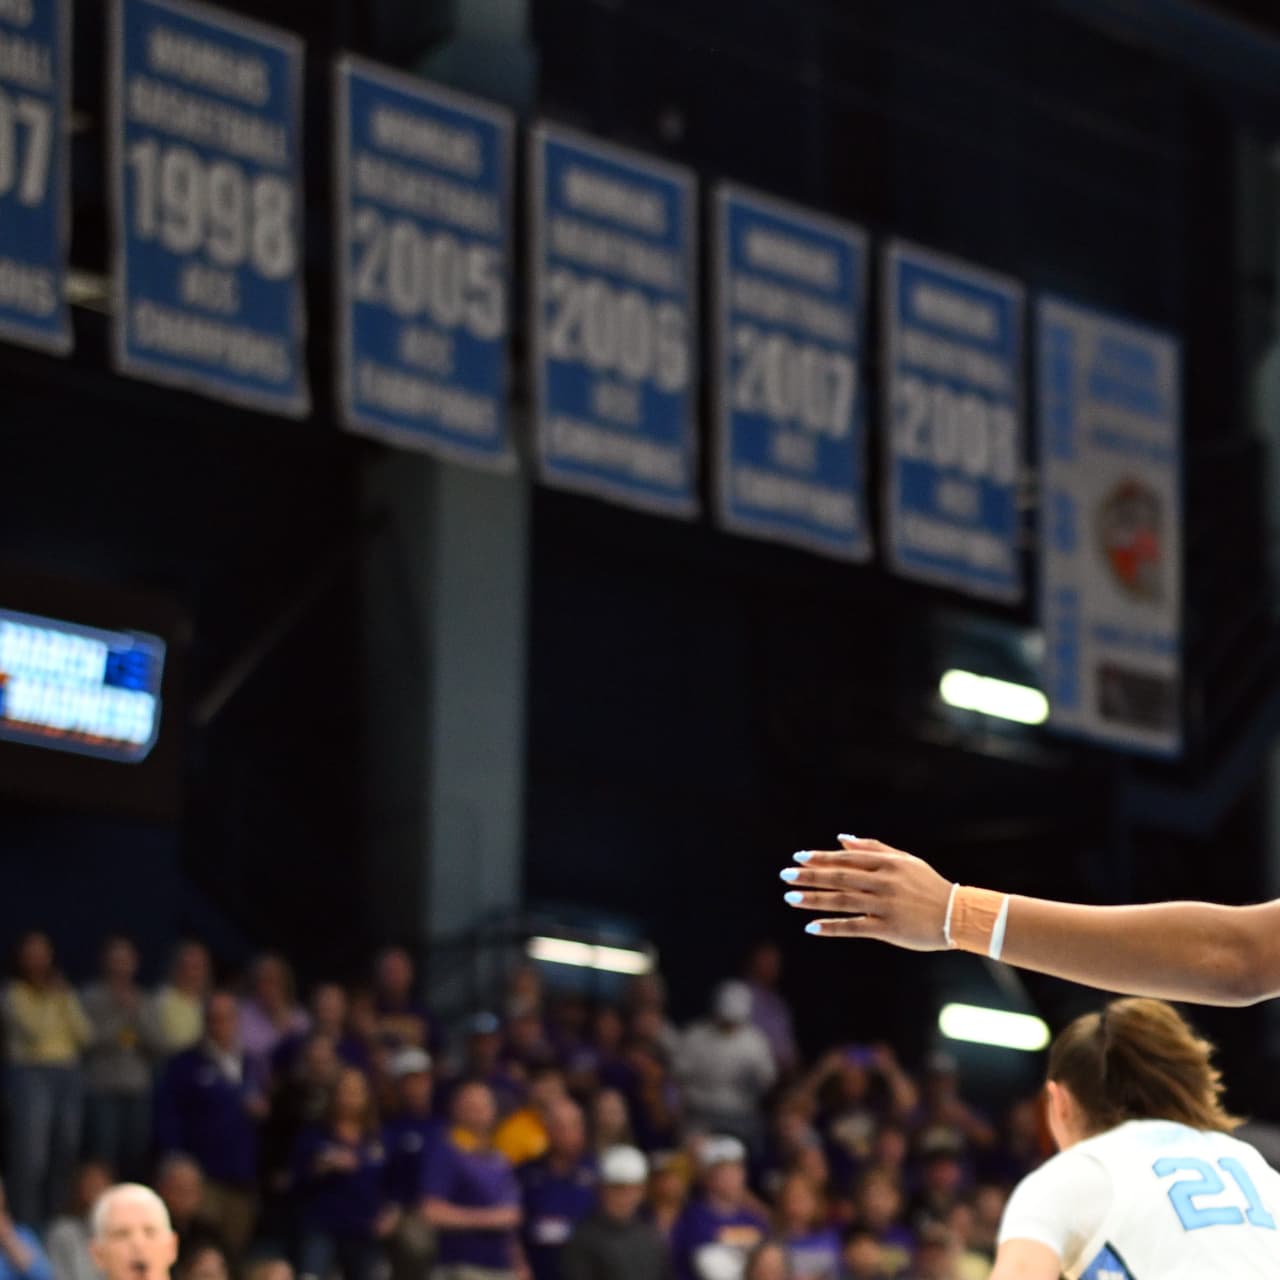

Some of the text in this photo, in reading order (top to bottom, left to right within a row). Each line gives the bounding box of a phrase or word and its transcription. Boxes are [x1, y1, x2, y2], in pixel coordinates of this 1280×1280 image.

[130, 137, 297, 282] 1998
[352, 207, 506, 341] 2005
[1152, 1156, 1277, 1232] 21
